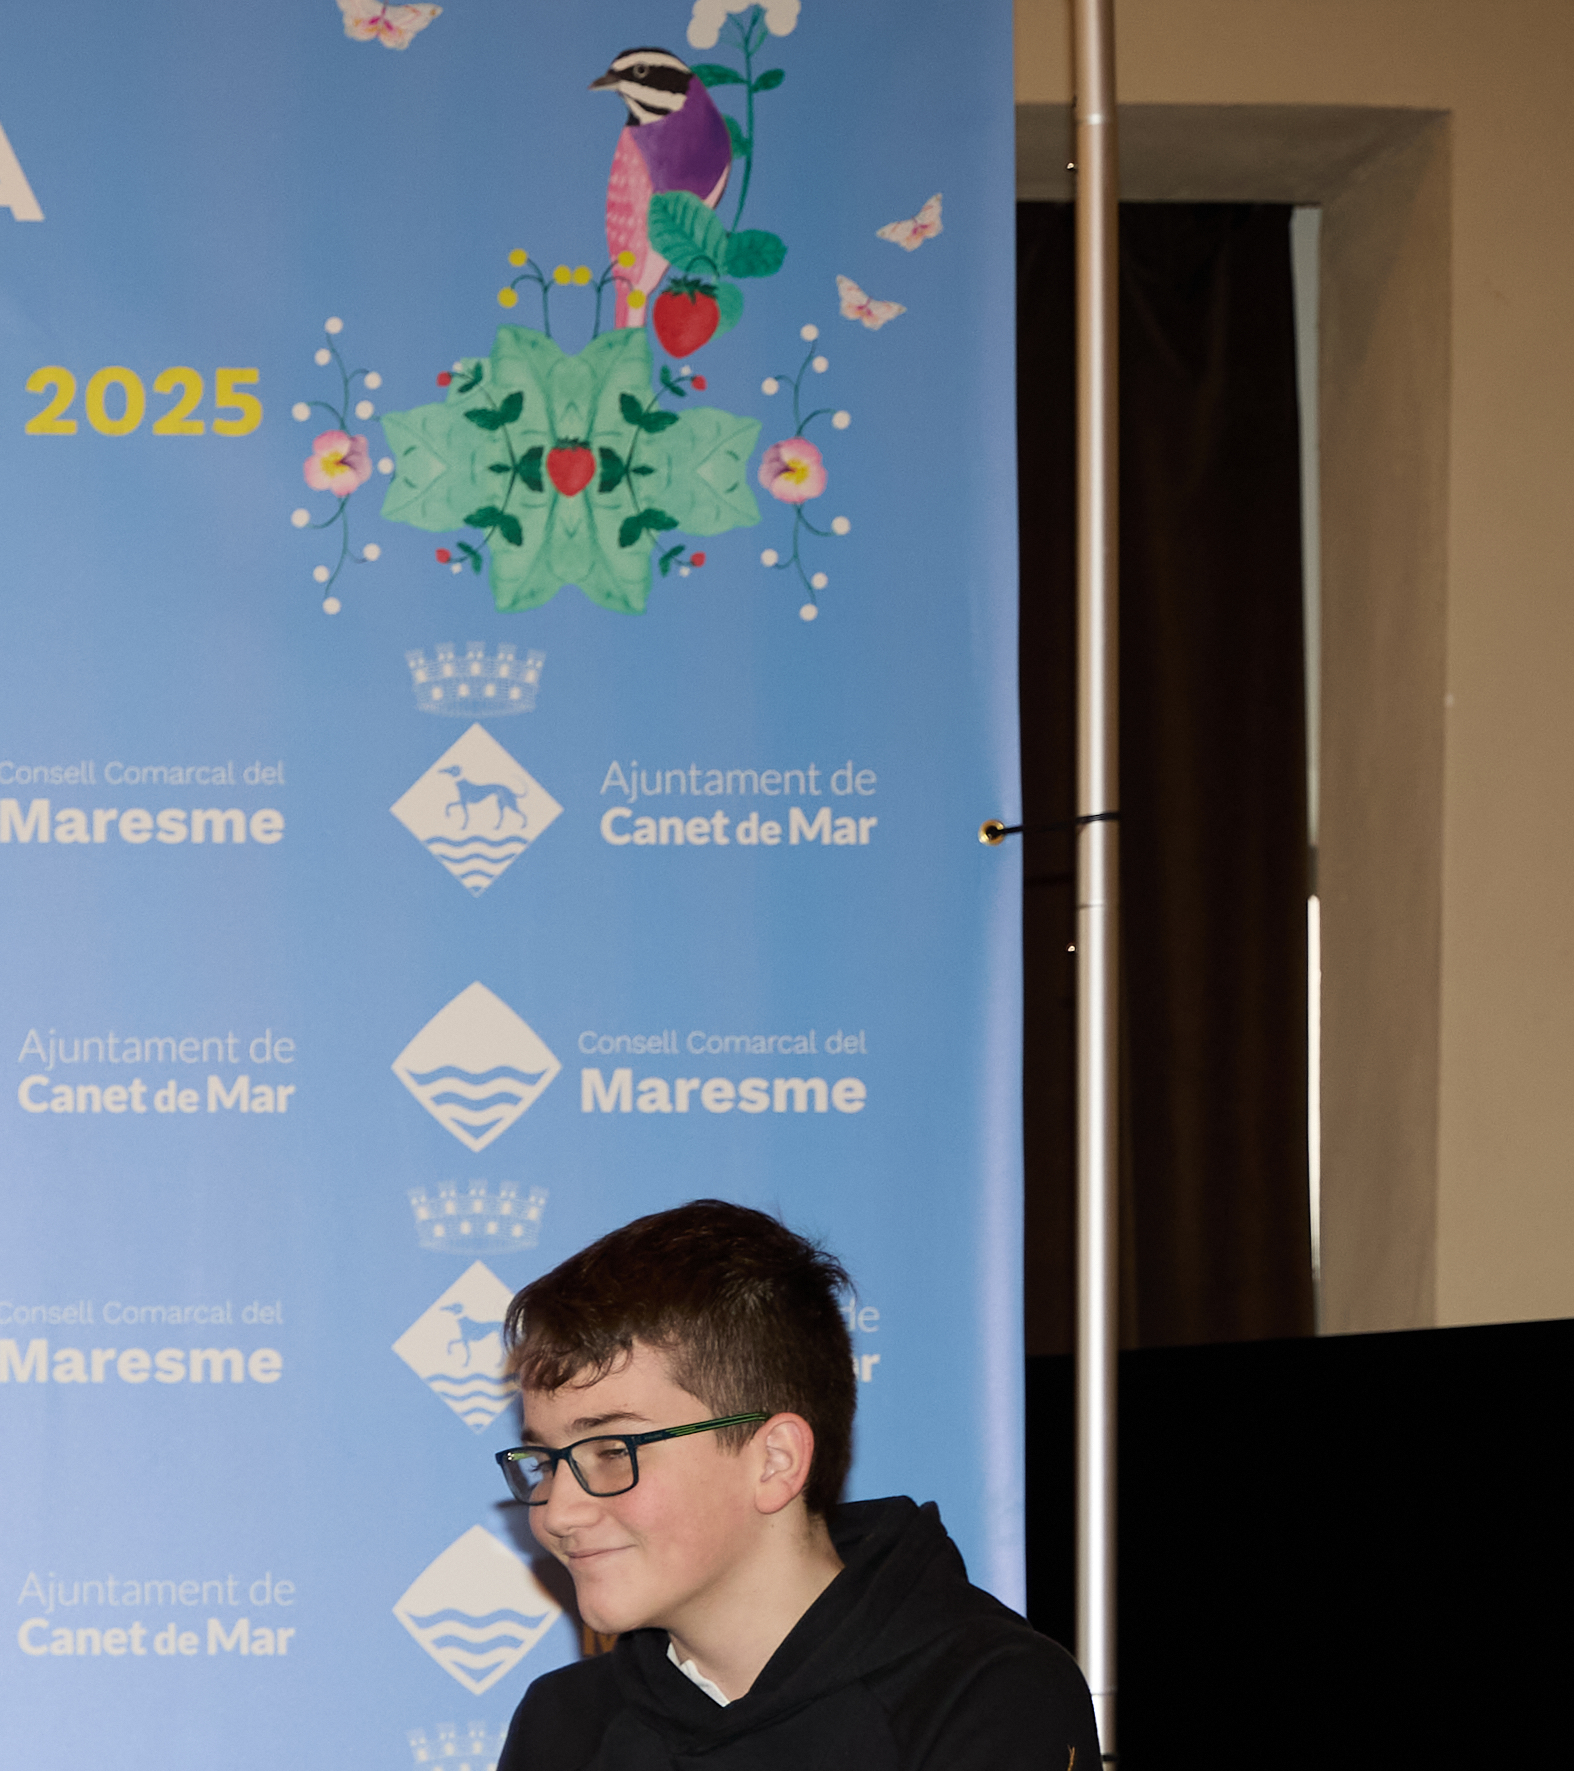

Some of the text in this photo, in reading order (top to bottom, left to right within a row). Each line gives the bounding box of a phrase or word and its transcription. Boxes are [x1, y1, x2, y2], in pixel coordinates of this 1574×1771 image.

[26, 367, 262, 436] 2025
[104, 761, 236, 785] Comarcal
[243, 761, 285, 785] del
[600, 761, 877, 803] Ajuntament de
[0, 799, 284, 844] Maresme
[601, 807, 877, 845] Canet de Mar
